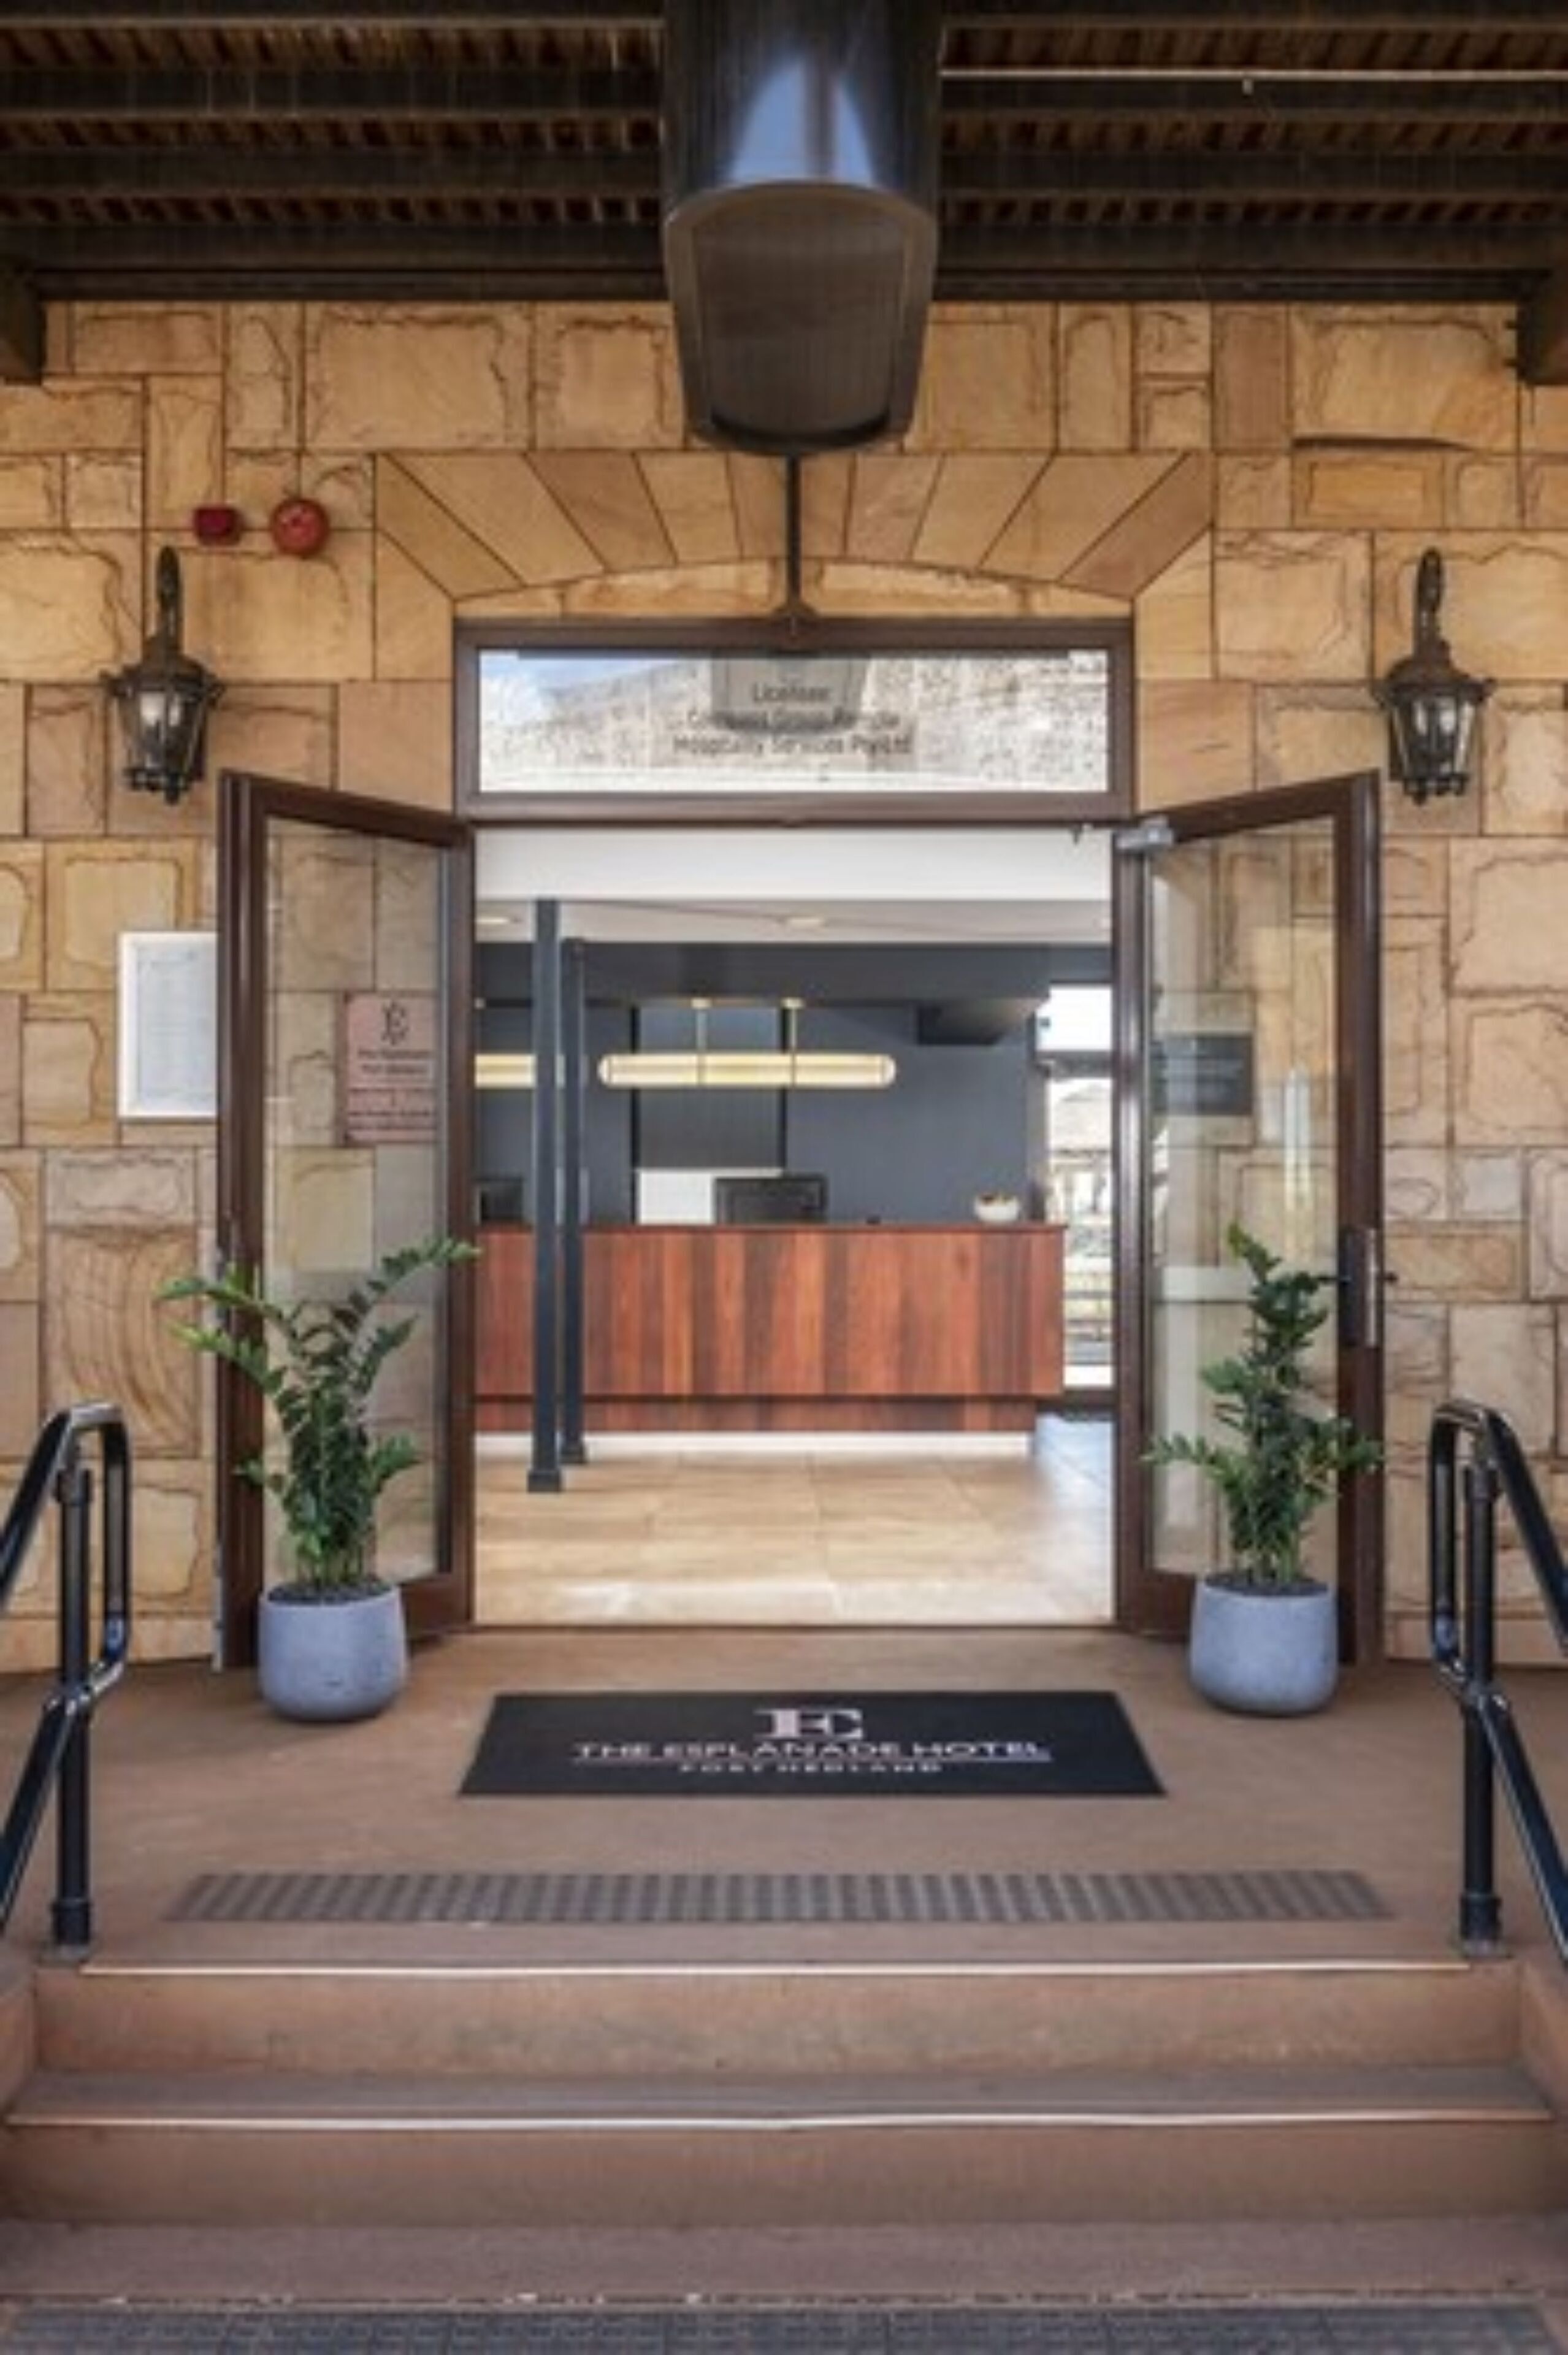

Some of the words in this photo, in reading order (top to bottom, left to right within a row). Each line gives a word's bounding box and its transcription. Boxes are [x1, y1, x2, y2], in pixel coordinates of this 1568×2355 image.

[573, 1742, 651, 1760] THE
[663, 1742, 900, 1761] ESPLANADE
[912, 1742, 1046, 1761] HOTEL
